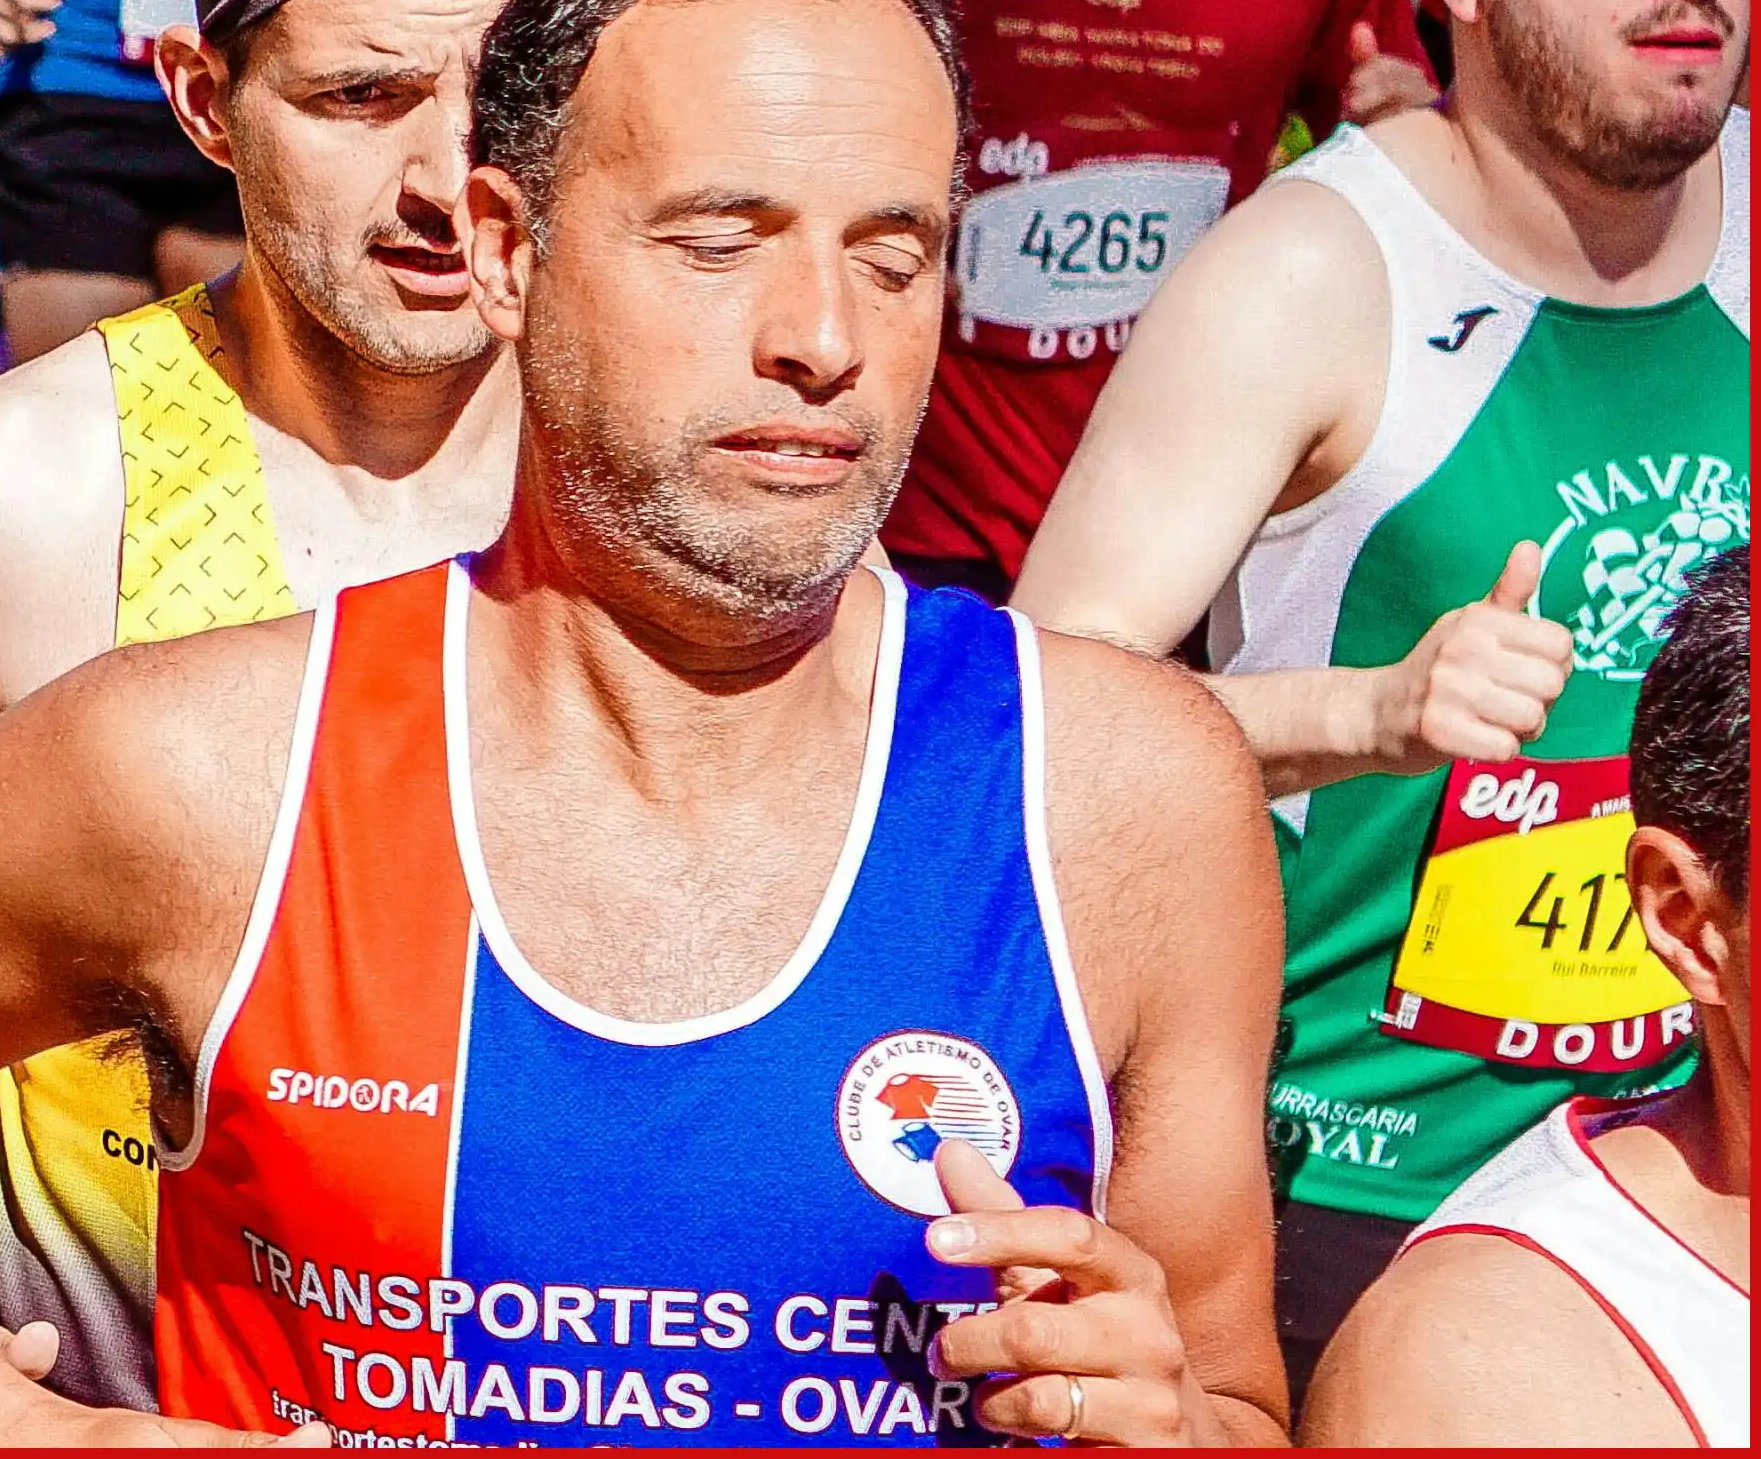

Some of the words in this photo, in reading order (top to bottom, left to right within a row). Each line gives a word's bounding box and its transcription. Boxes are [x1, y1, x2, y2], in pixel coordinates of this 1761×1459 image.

[1019, 206, 1171, 273] 4265
[1029, 322, 1134, 360] DOU
[1458, 768, 1560, 836] edp
[1515, 871, 1652, 954] 417
[1496, 1001, 1694, 1065] DOUR
[266, 1067, 440, 1118] SPIDORA
[846, 1079, 867, 1143] CLUBE
[861, 1055, 884, 1078] DE
[885, 1040, 982, 1070] ATLETISMO
[982, 1070, 1003, 1096] DE
[996, 1100, 1015, 1152] OVAR
[1271, 1081, 1419, 1138] URRASCARIA
[1266, 1115, 1400, 1171] OYAL
[244, 1230, 751, 1349] TRANSPORTES
[322, 1341, 711, 1429] TOMADIAS
[781, 1375, 971, 1435] OVAR
